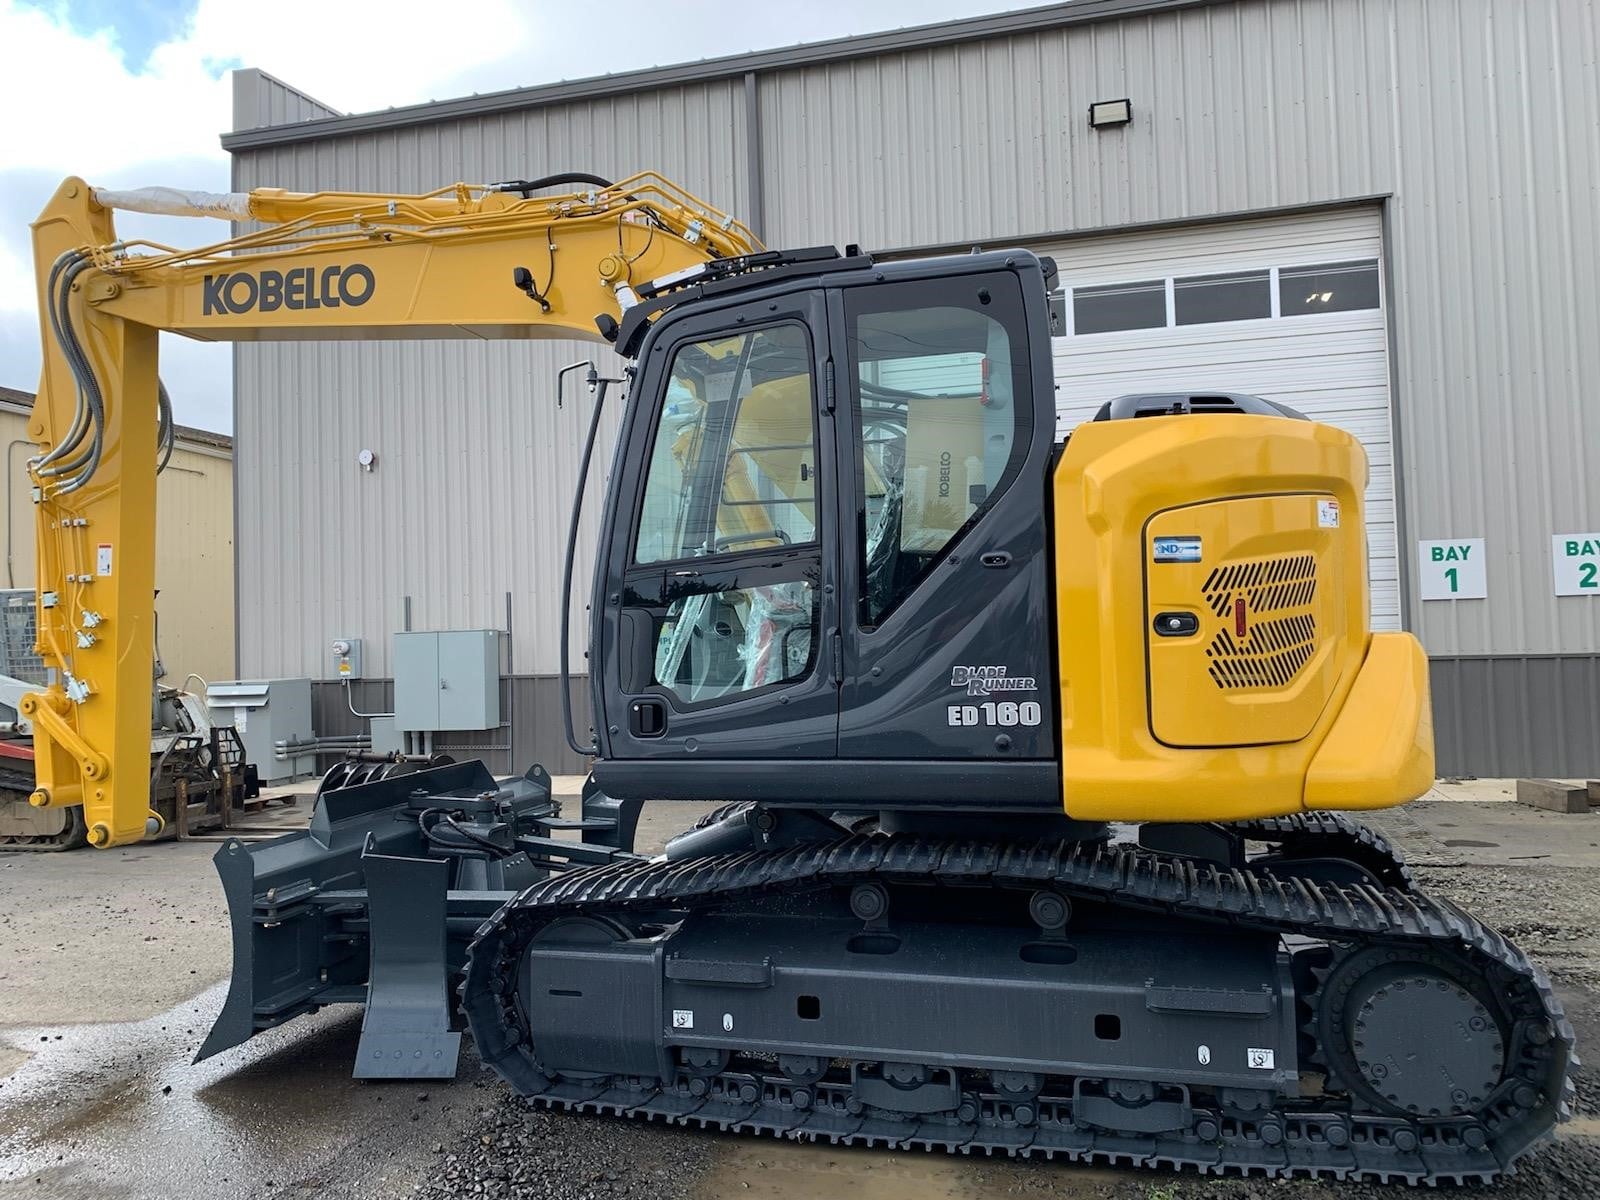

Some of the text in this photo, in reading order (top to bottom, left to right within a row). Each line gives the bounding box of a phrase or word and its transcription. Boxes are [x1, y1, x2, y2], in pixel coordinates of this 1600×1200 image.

[203, 263, 376, 316] KOBELCO
[938, 451, 951, 498] KOBELCO
[1431, 545, 1472, 562] BAY
[1444, 568, 1458, 593] 1
[1578, 562, 1598, 588] 2
[951, 666, 1007, 686] BLADE
[967, 677, 1038, 696] RUNNER
